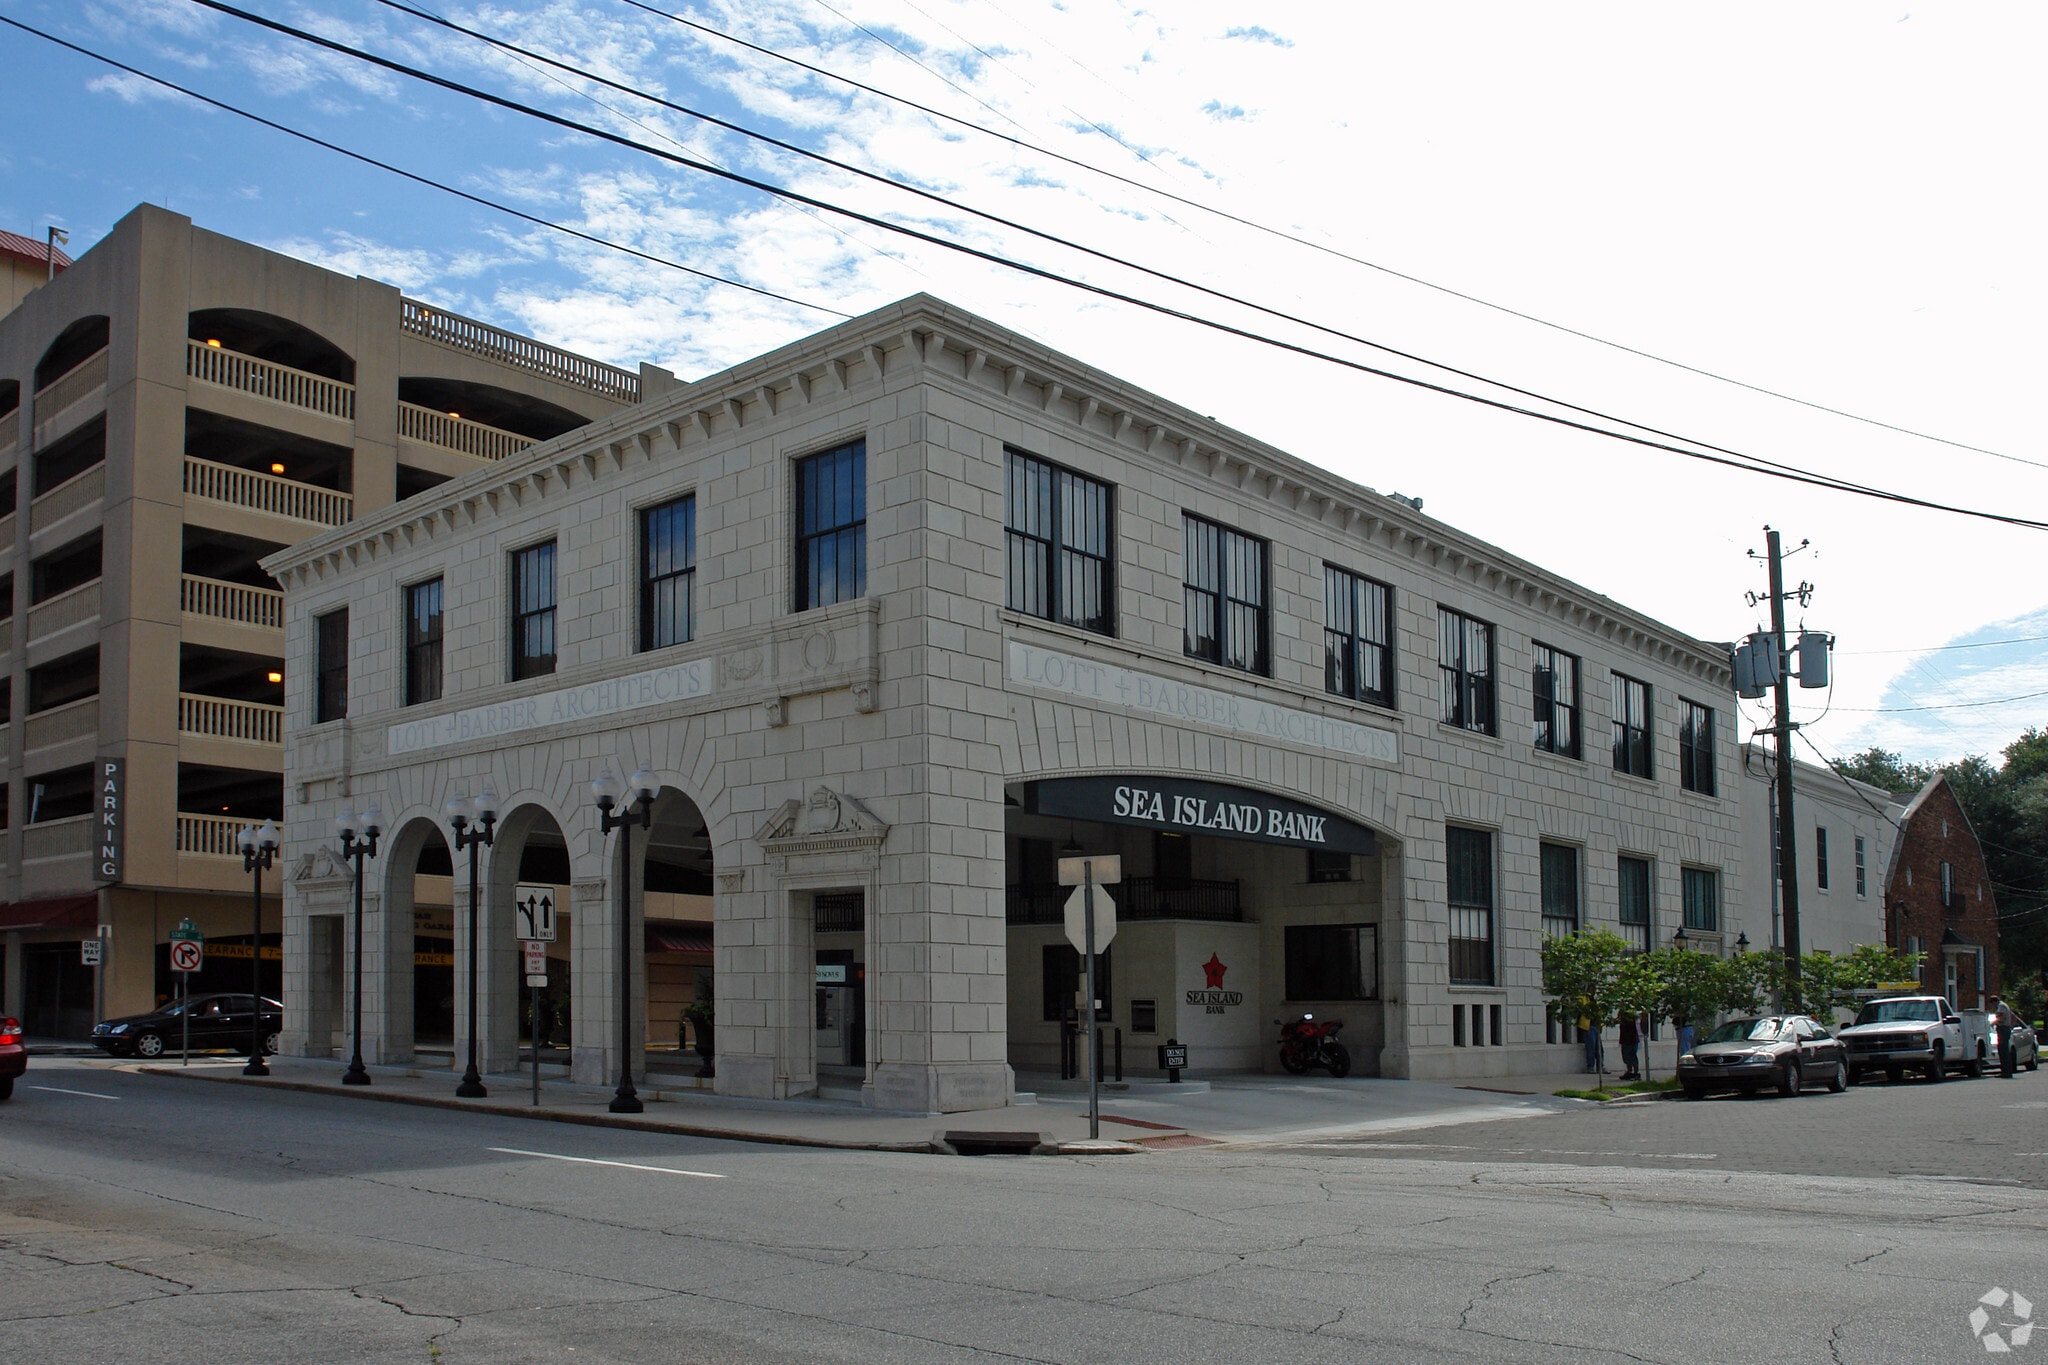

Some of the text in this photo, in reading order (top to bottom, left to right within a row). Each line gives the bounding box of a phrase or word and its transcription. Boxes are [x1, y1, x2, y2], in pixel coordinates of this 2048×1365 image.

[394, 719, 441, 751] LOTT
[456, 698, 539, 739] BARBER
[549, 663, 702, 721] ARCHITECTS
[1022, 647, 1107, 697] LOTT
[1136, 676, 1245, 730] BARBER
[1255, 706, 1392, 759] ARCHITECTS
[102, 763, 117, 875] PARKING
[1113, 785, 1326, 843] SEA ISLAND BANK
[203, 945, 252, 957] LEARANC
[1186, 991, 1243, 1005] SEA ISLAND
[1206, 1006, 1225, 1014] BANK
[1166, 1048, 1185, 1057] DO NOT
[1168, 1057, 1184, 1065] ENTER
